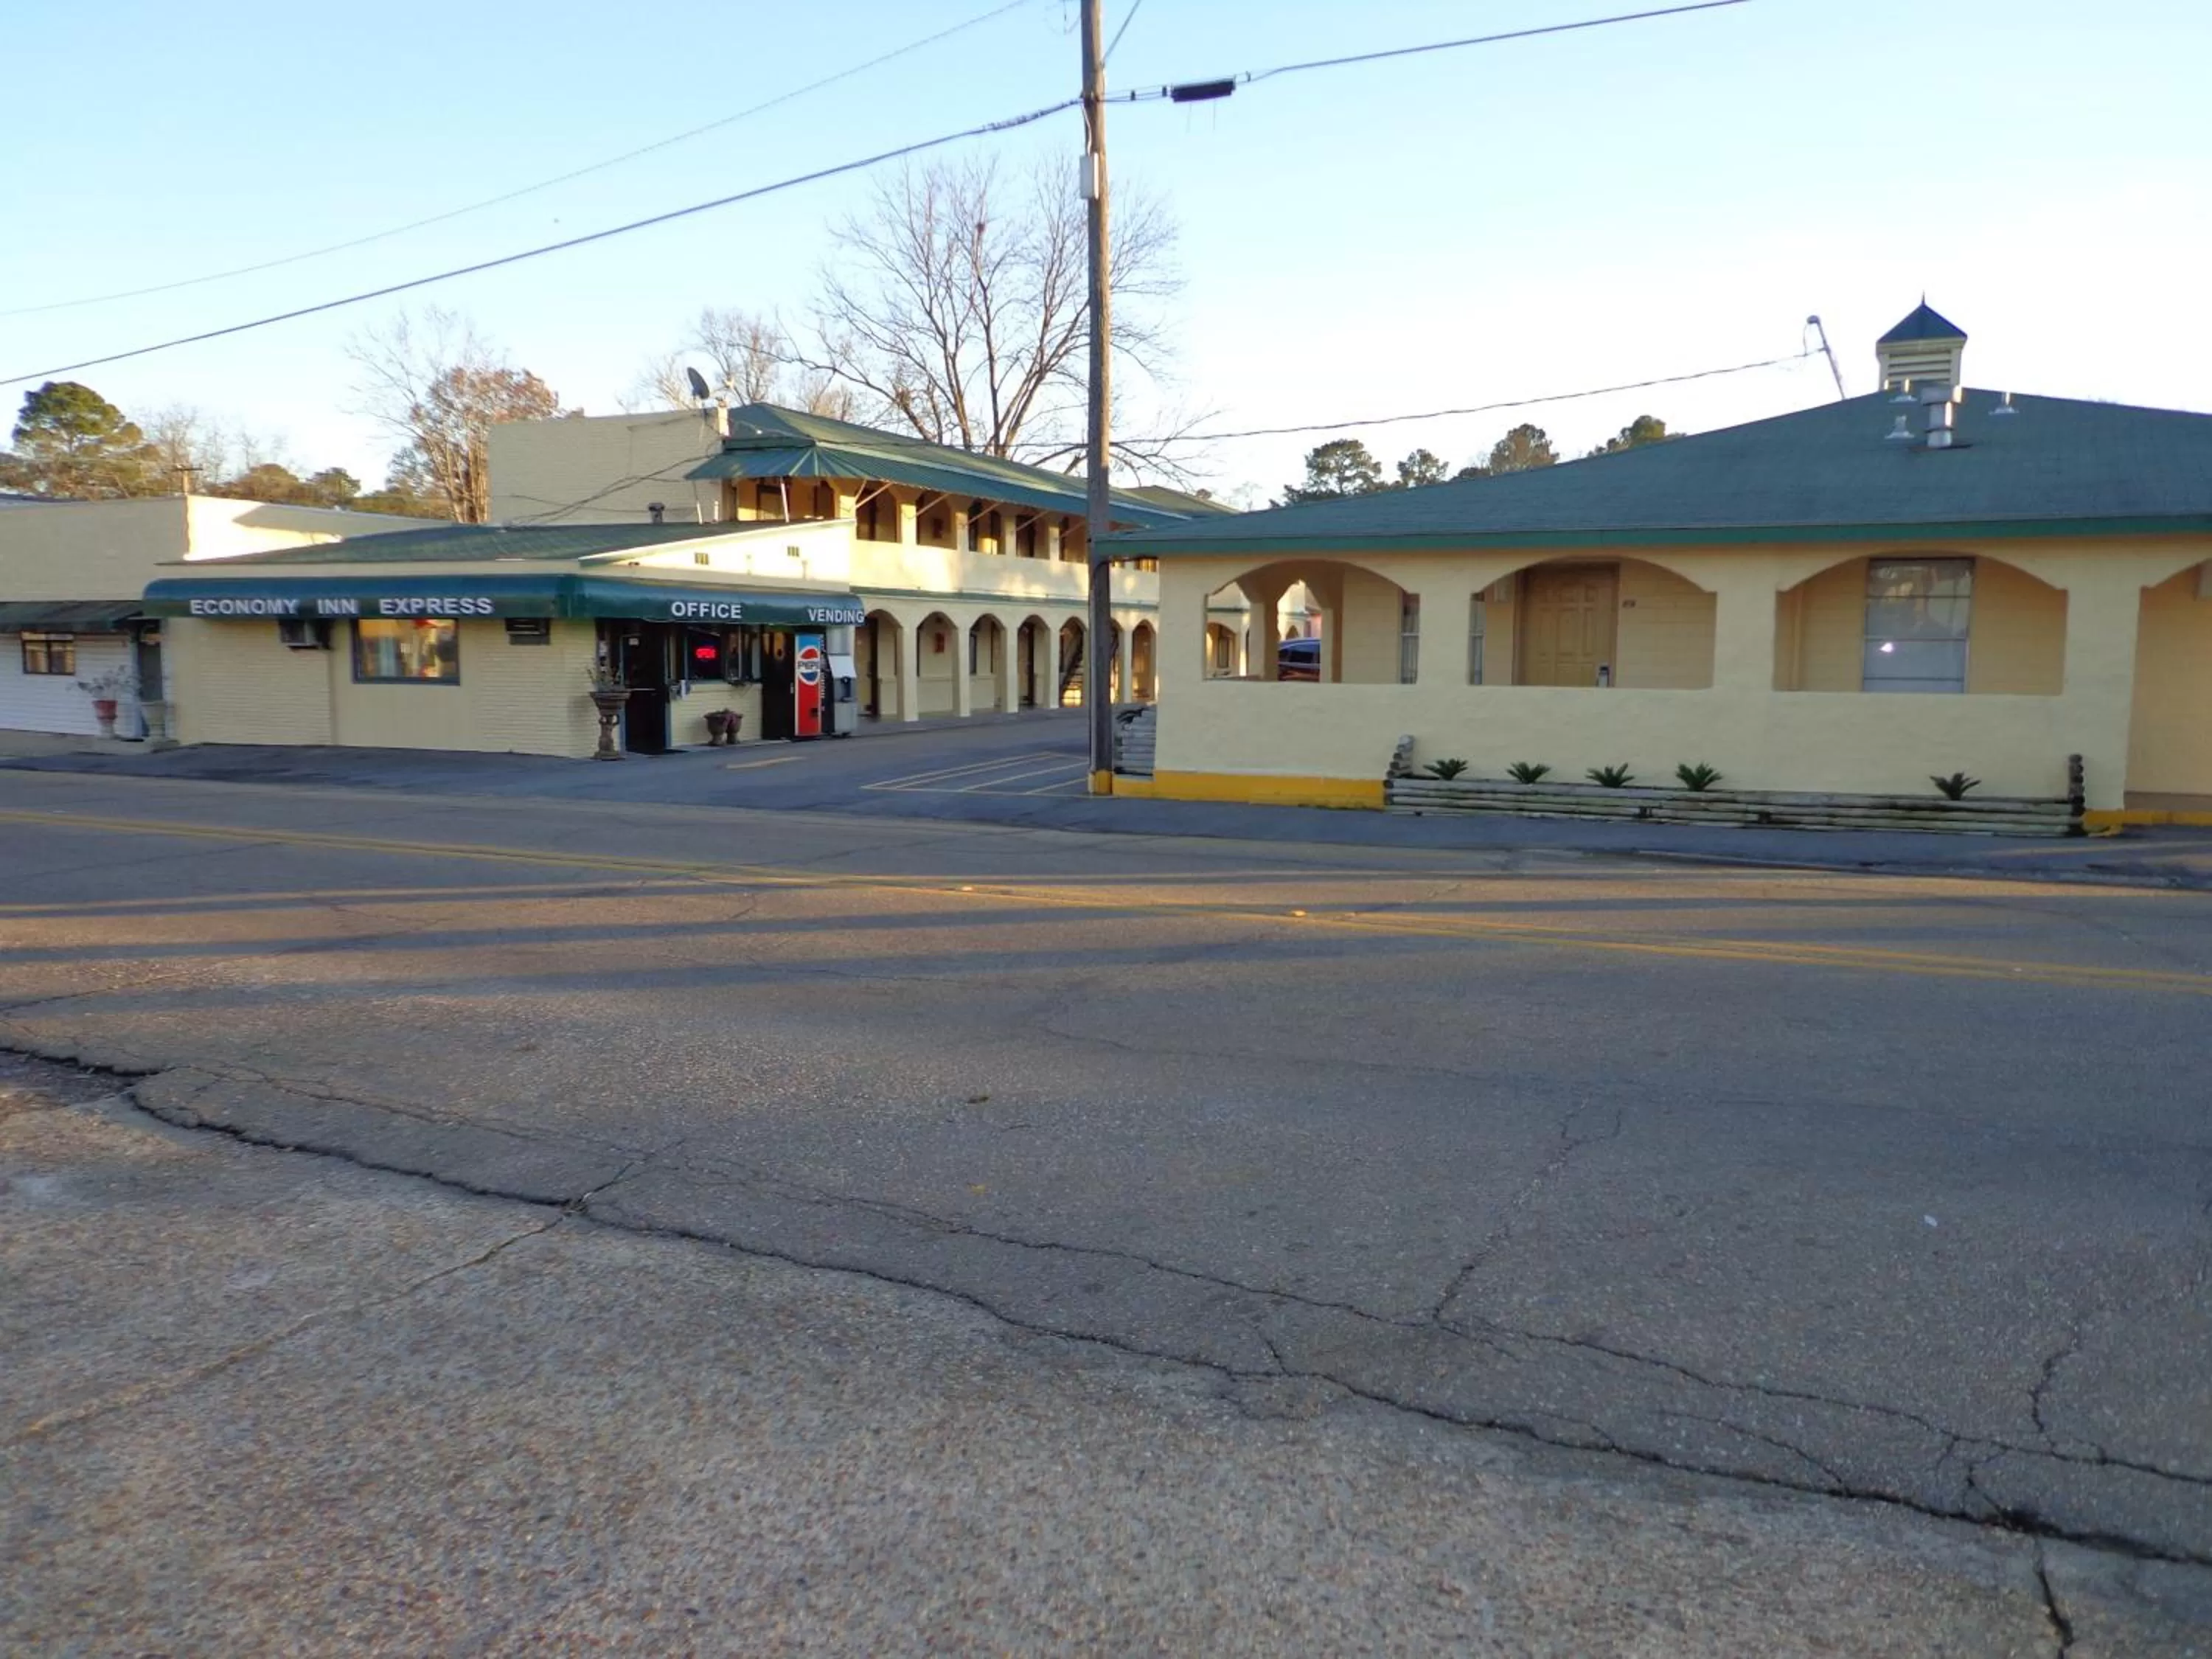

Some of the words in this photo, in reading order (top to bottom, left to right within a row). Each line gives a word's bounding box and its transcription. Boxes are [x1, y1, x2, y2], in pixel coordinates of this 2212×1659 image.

[189, 598, 298, 614] ECONOMY
[317, 598, 358, 614] INN
[378, 597, 494, 614] EXPRESS
[671, 601, 742, 619] OFFICE
[808, 608, 865, 624] VENDING
